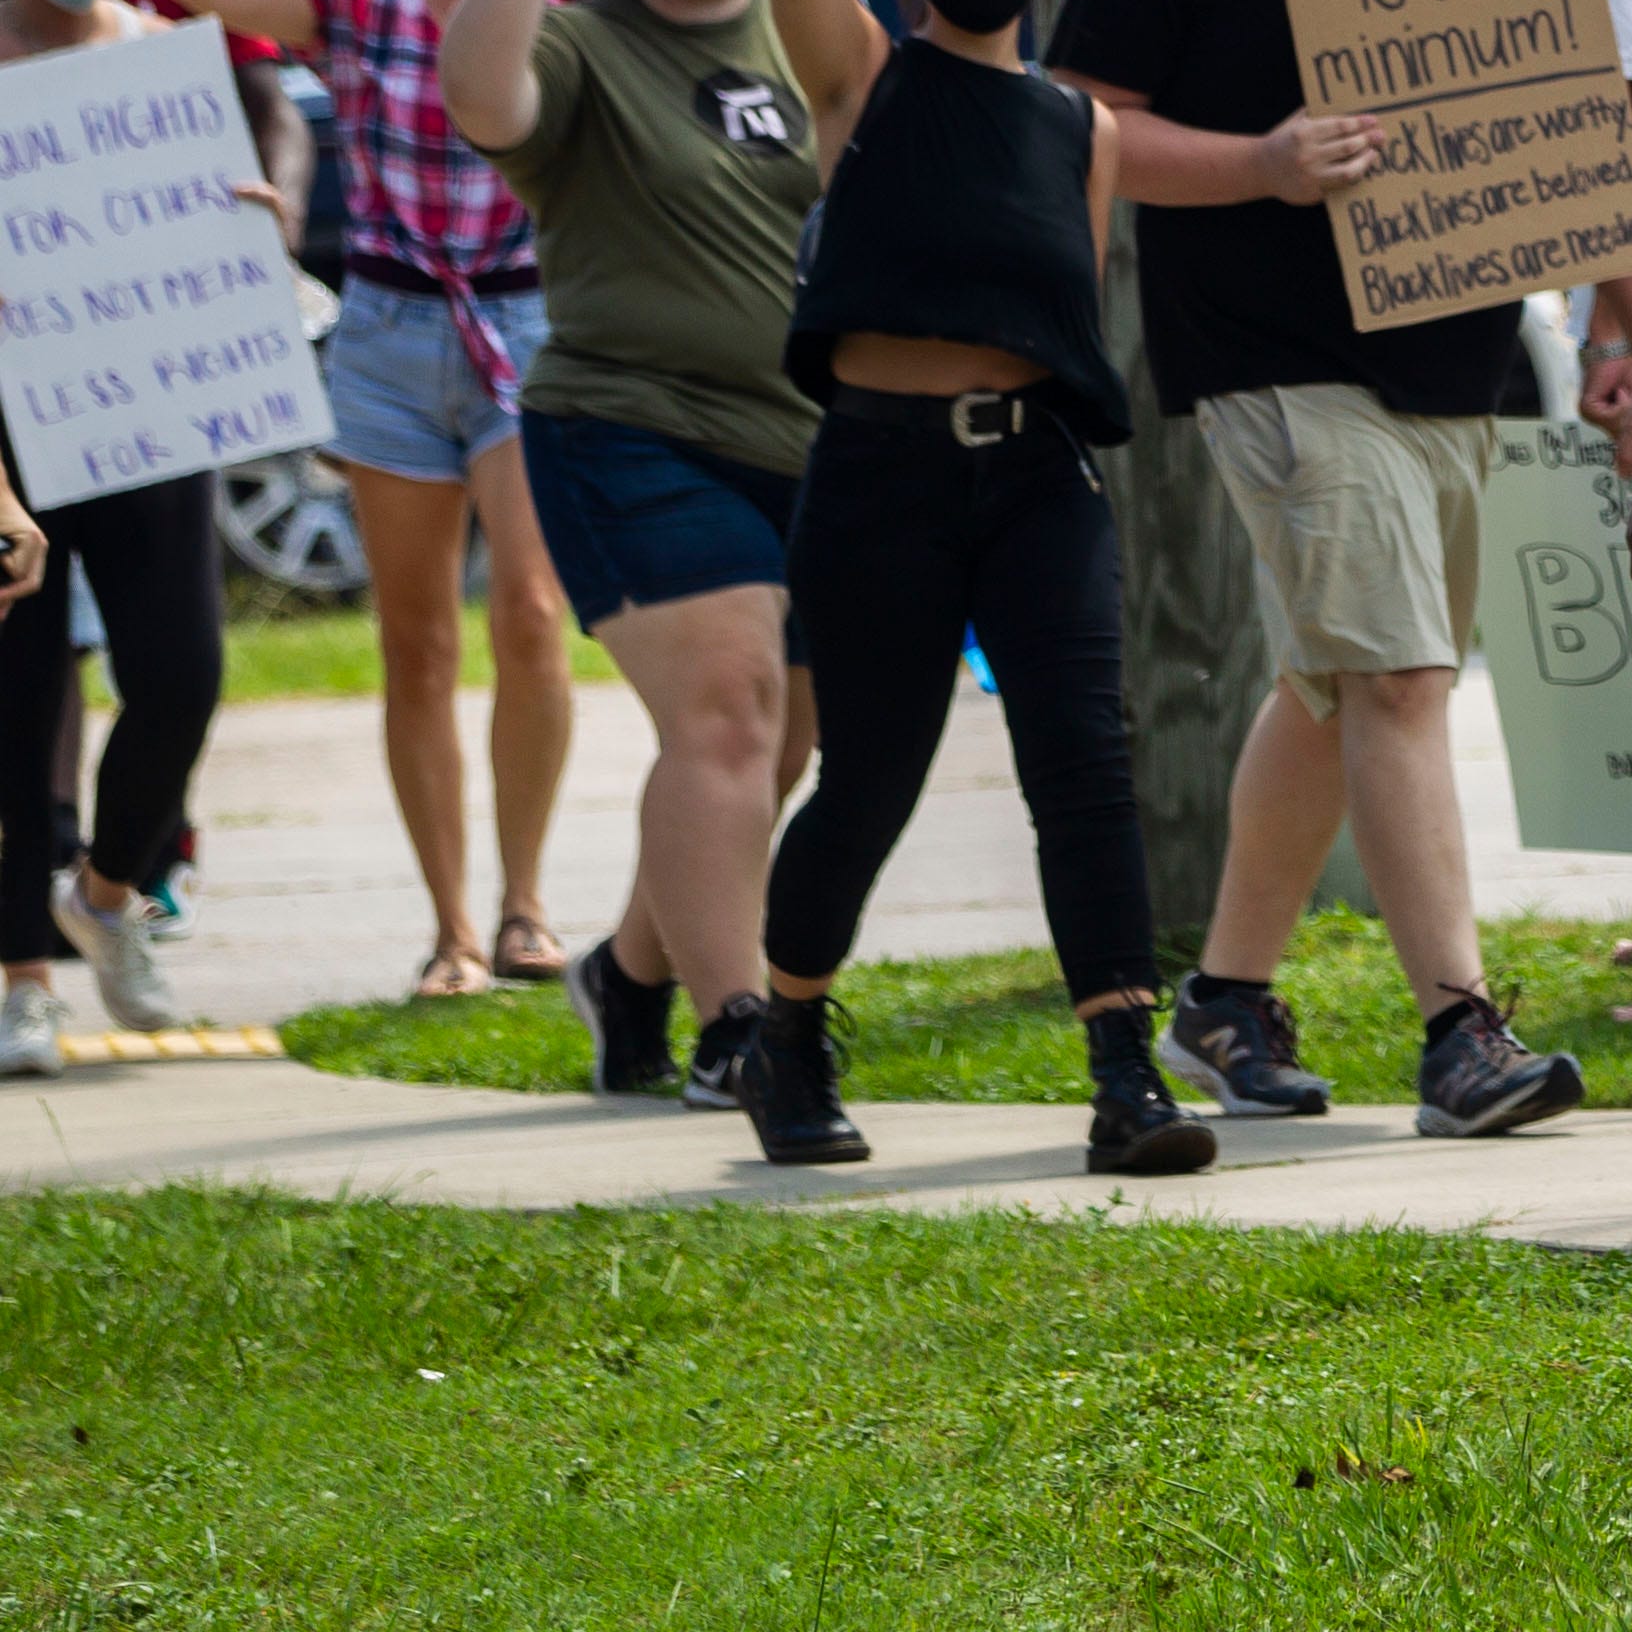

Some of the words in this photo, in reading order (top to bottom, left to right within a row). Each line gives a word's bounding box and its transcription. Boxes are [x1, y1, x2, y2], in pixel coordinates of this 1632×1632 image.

[1490, 115, 1536, 156] are
[4, 210, 97, 257] FOR
[1349, 196, 1431, 257] Black
[1422, 189, 1485, 237] lives
[1481, 178, 1533, 216] are
[82, 277, 156, 326] NOT
[1360, 261, 1444, 316] Black
[1434, 250, 1512, 302] lives
[1510, 236, 1568, 280] are
[22, 368, 137, 427] LESS
[82, 430, 174, 487] FOR
